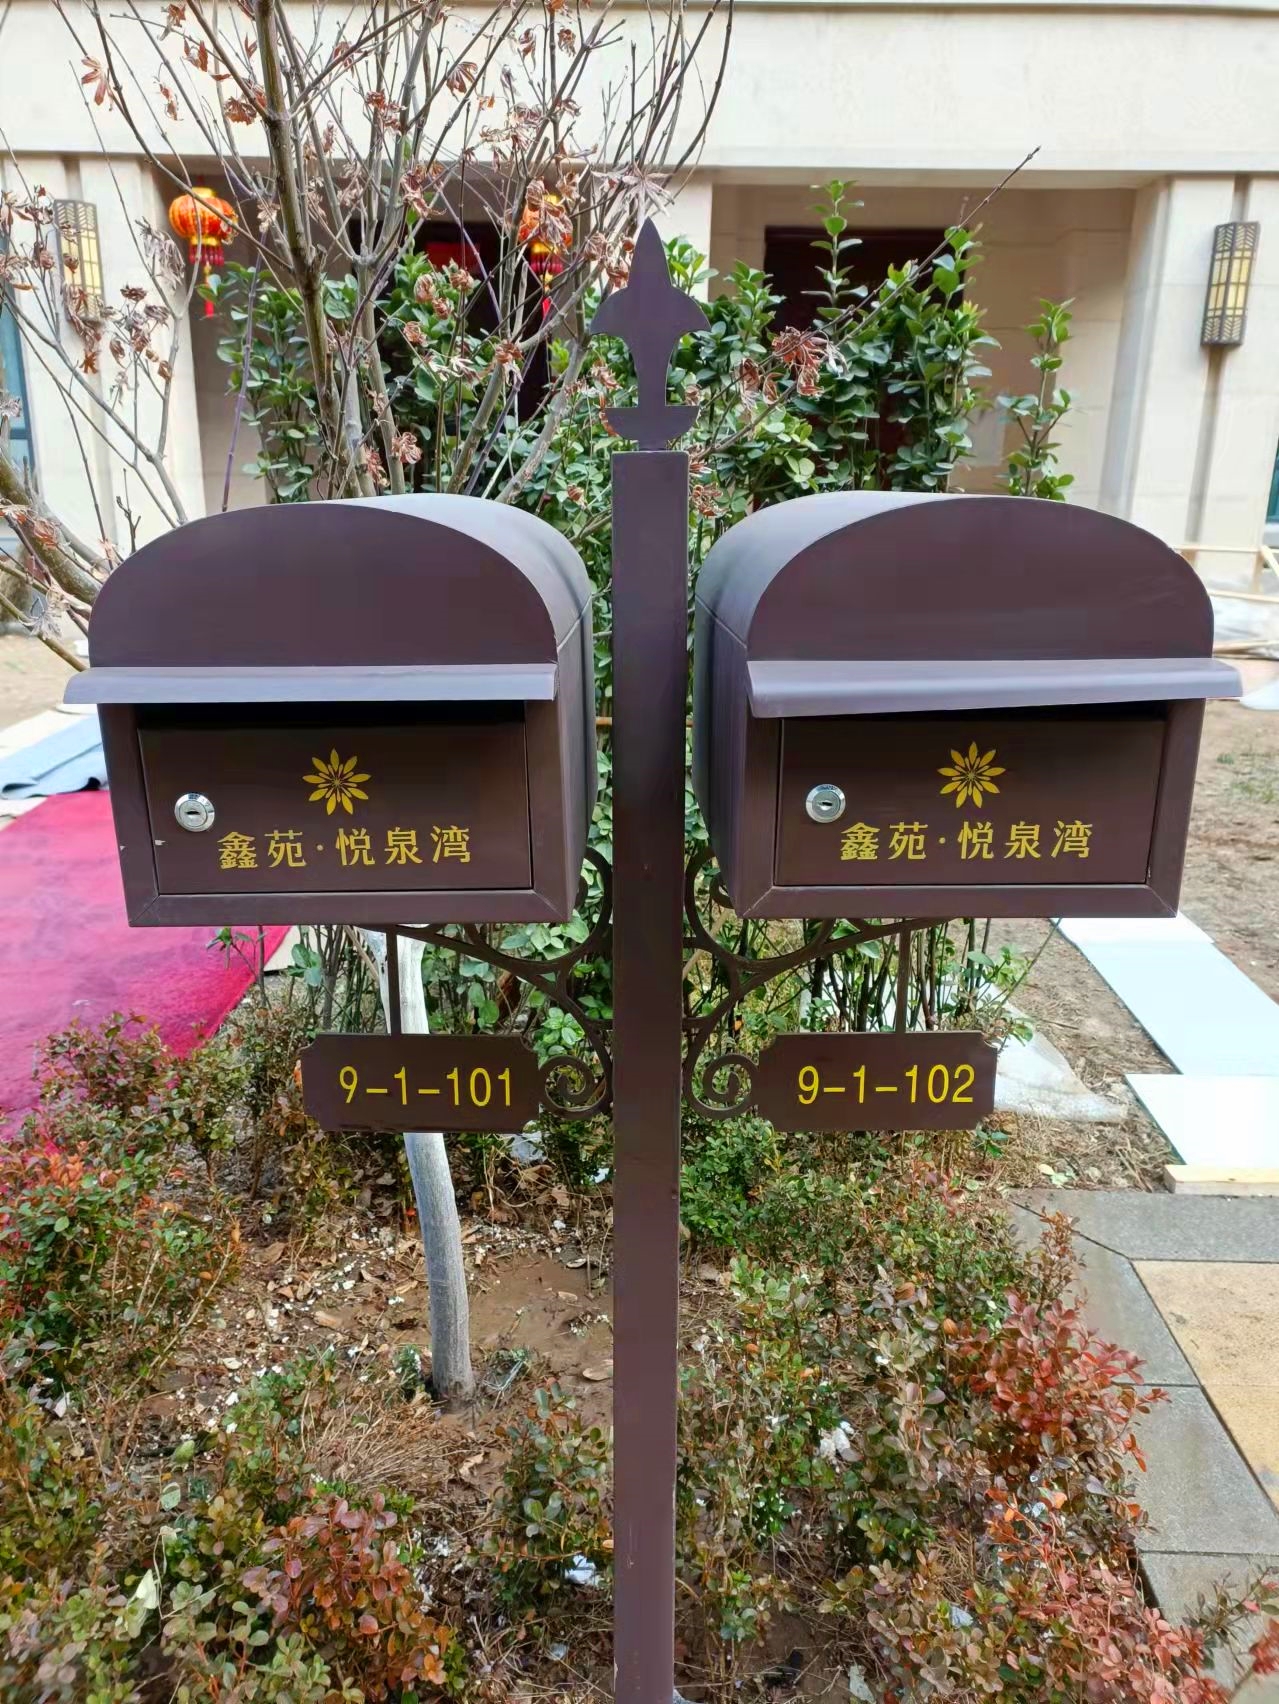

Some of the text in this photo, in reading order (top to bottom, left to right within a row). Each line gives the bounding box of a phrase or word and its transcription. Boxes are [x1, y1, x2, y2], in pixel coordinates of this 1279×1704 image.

[216, 825, 471, 869] 鑫苑·悦泉湾
[840, 820, 1093, 861] 鑫苑·悦泉湾
[339, 1065, 511, 1107] 9-1-101
[797, 1064, 975, 1105] 9-1-102
